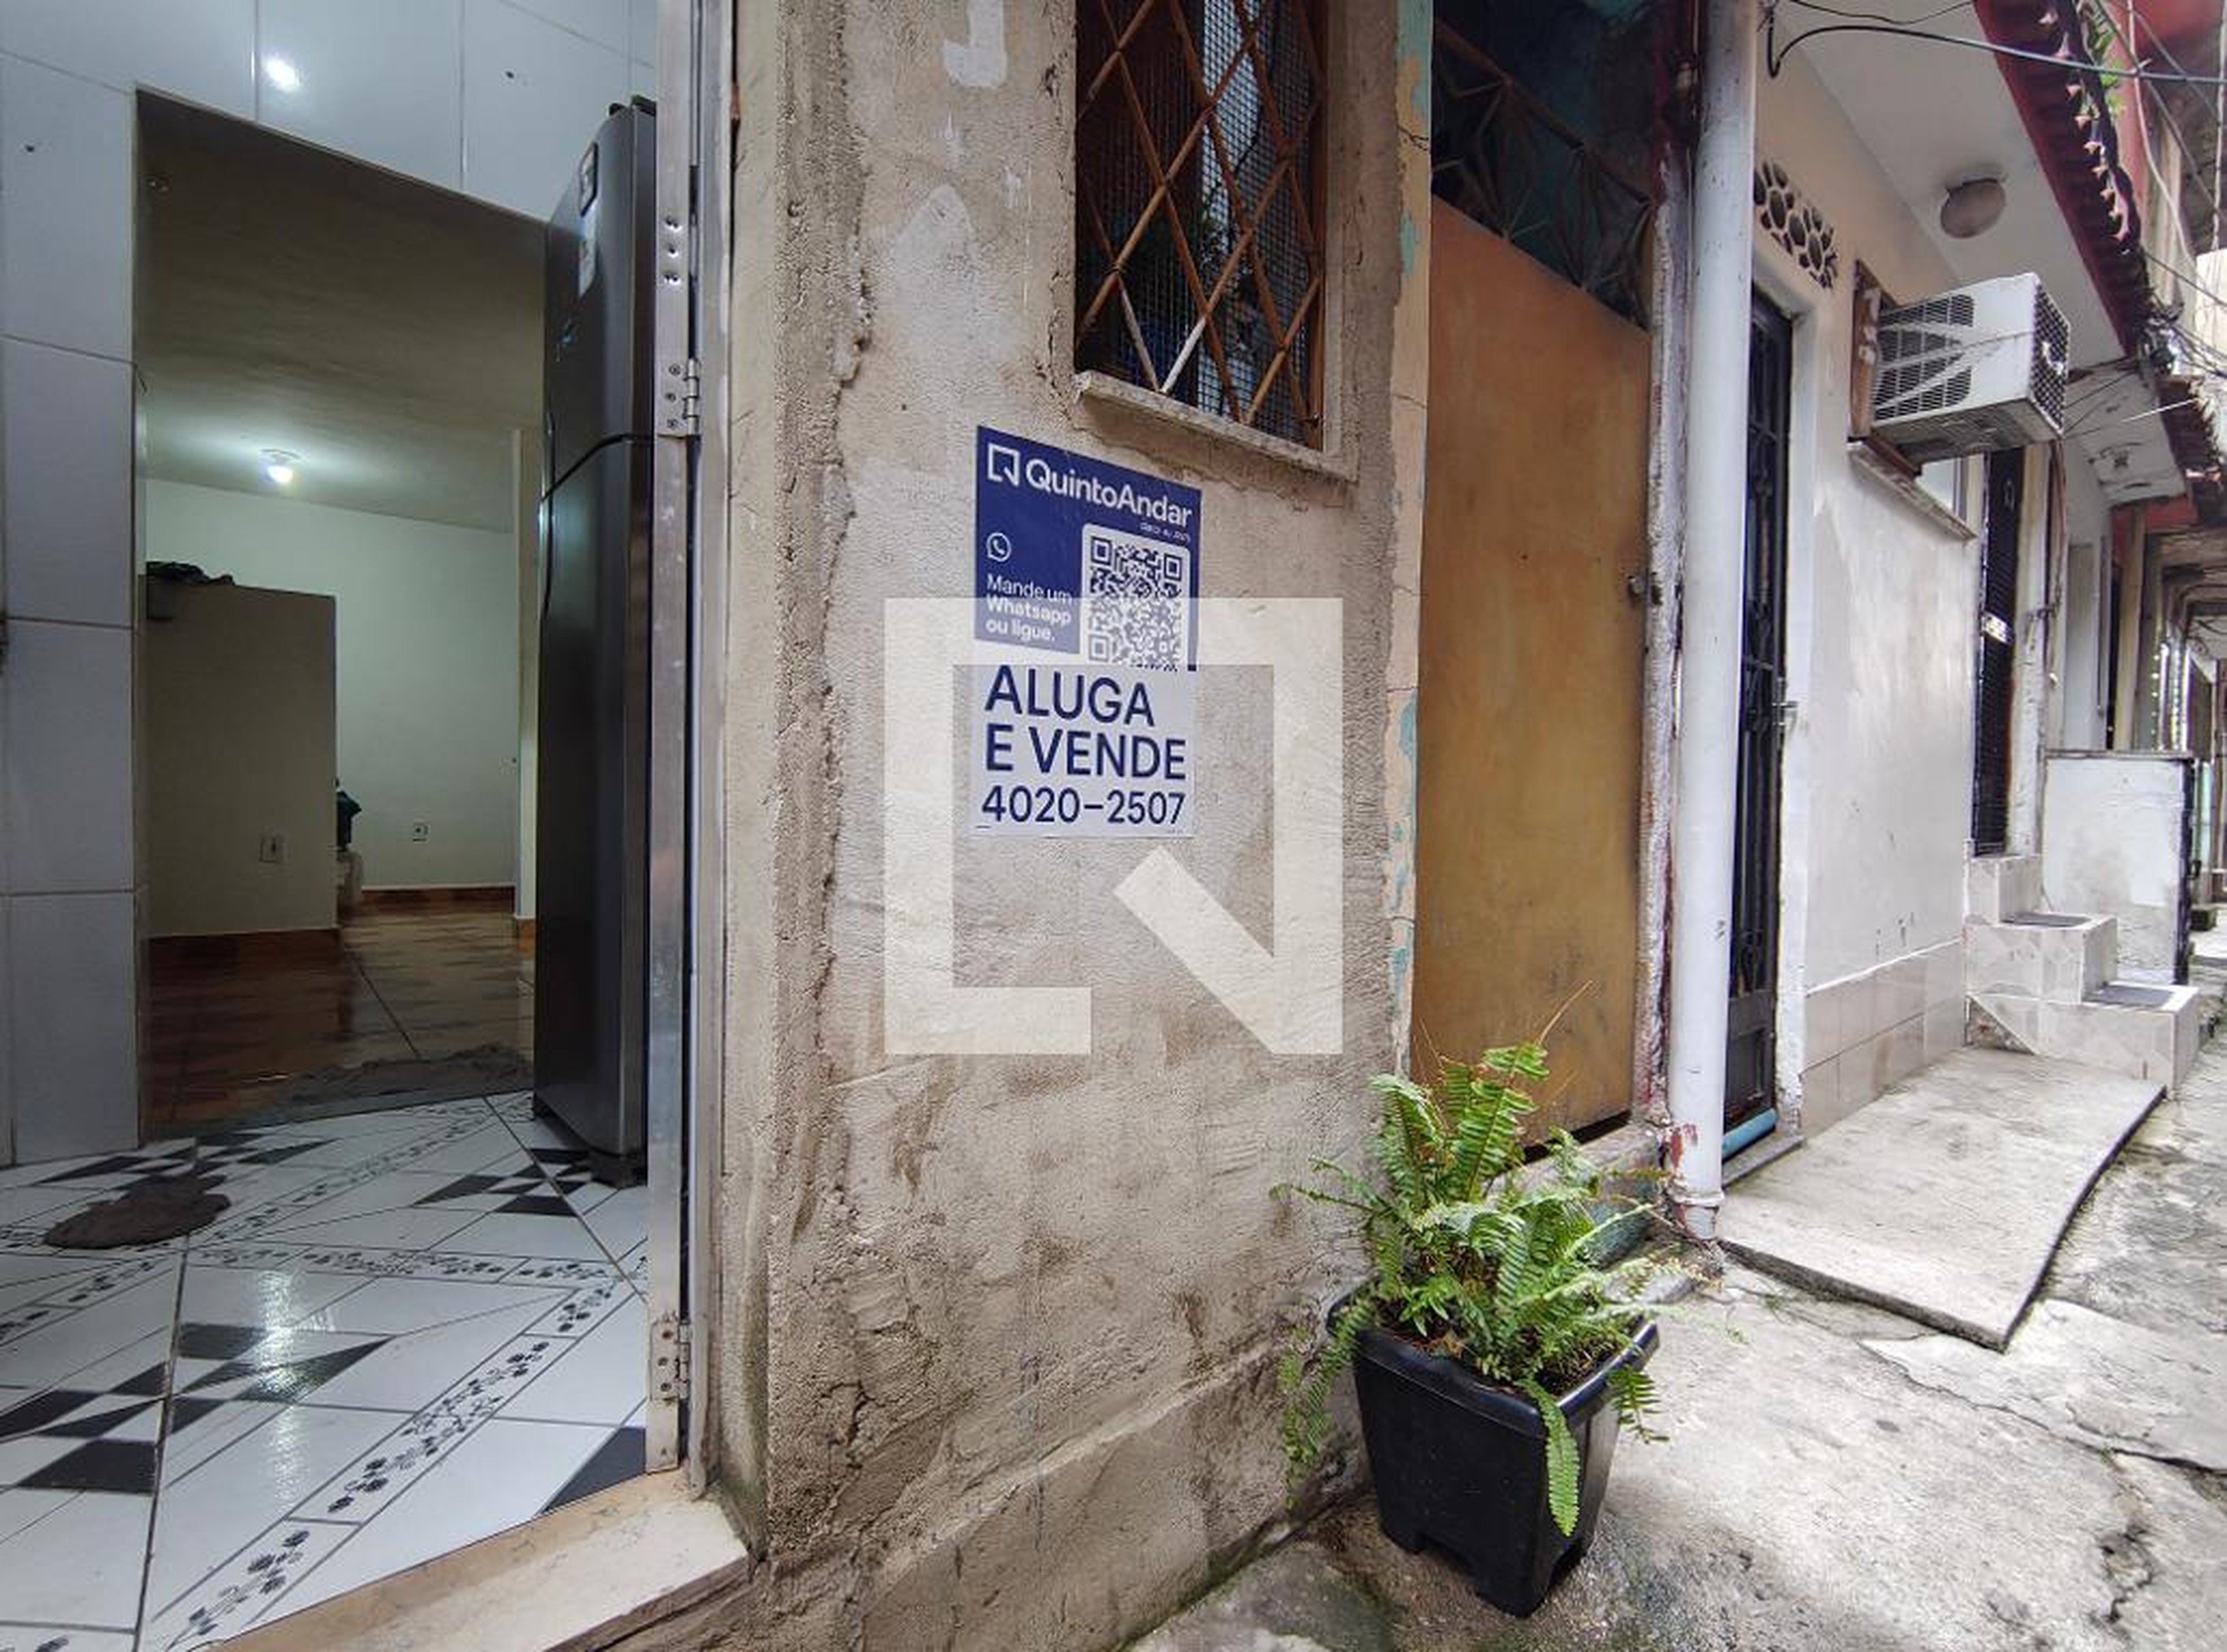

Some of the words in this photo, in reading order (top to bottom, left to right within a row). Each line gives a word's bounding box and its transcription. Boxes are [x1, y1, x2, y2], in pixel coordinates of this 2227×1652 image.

[1025, 459, 1192, 528] QuintoAndar
[986, 573, 1043, 601] Mande
[1047, 589, 1072, 605] um
[986, 594, 1072, 627] Whatsapp
[986, 619, 1008, 634] ou
[984, 665, 1155, 727] ALUGA
[986, 723, 1014, 771] E
[1028, 726, 1186, 780] VENDE
[982, 785, 1185, 825] 4020-2507
